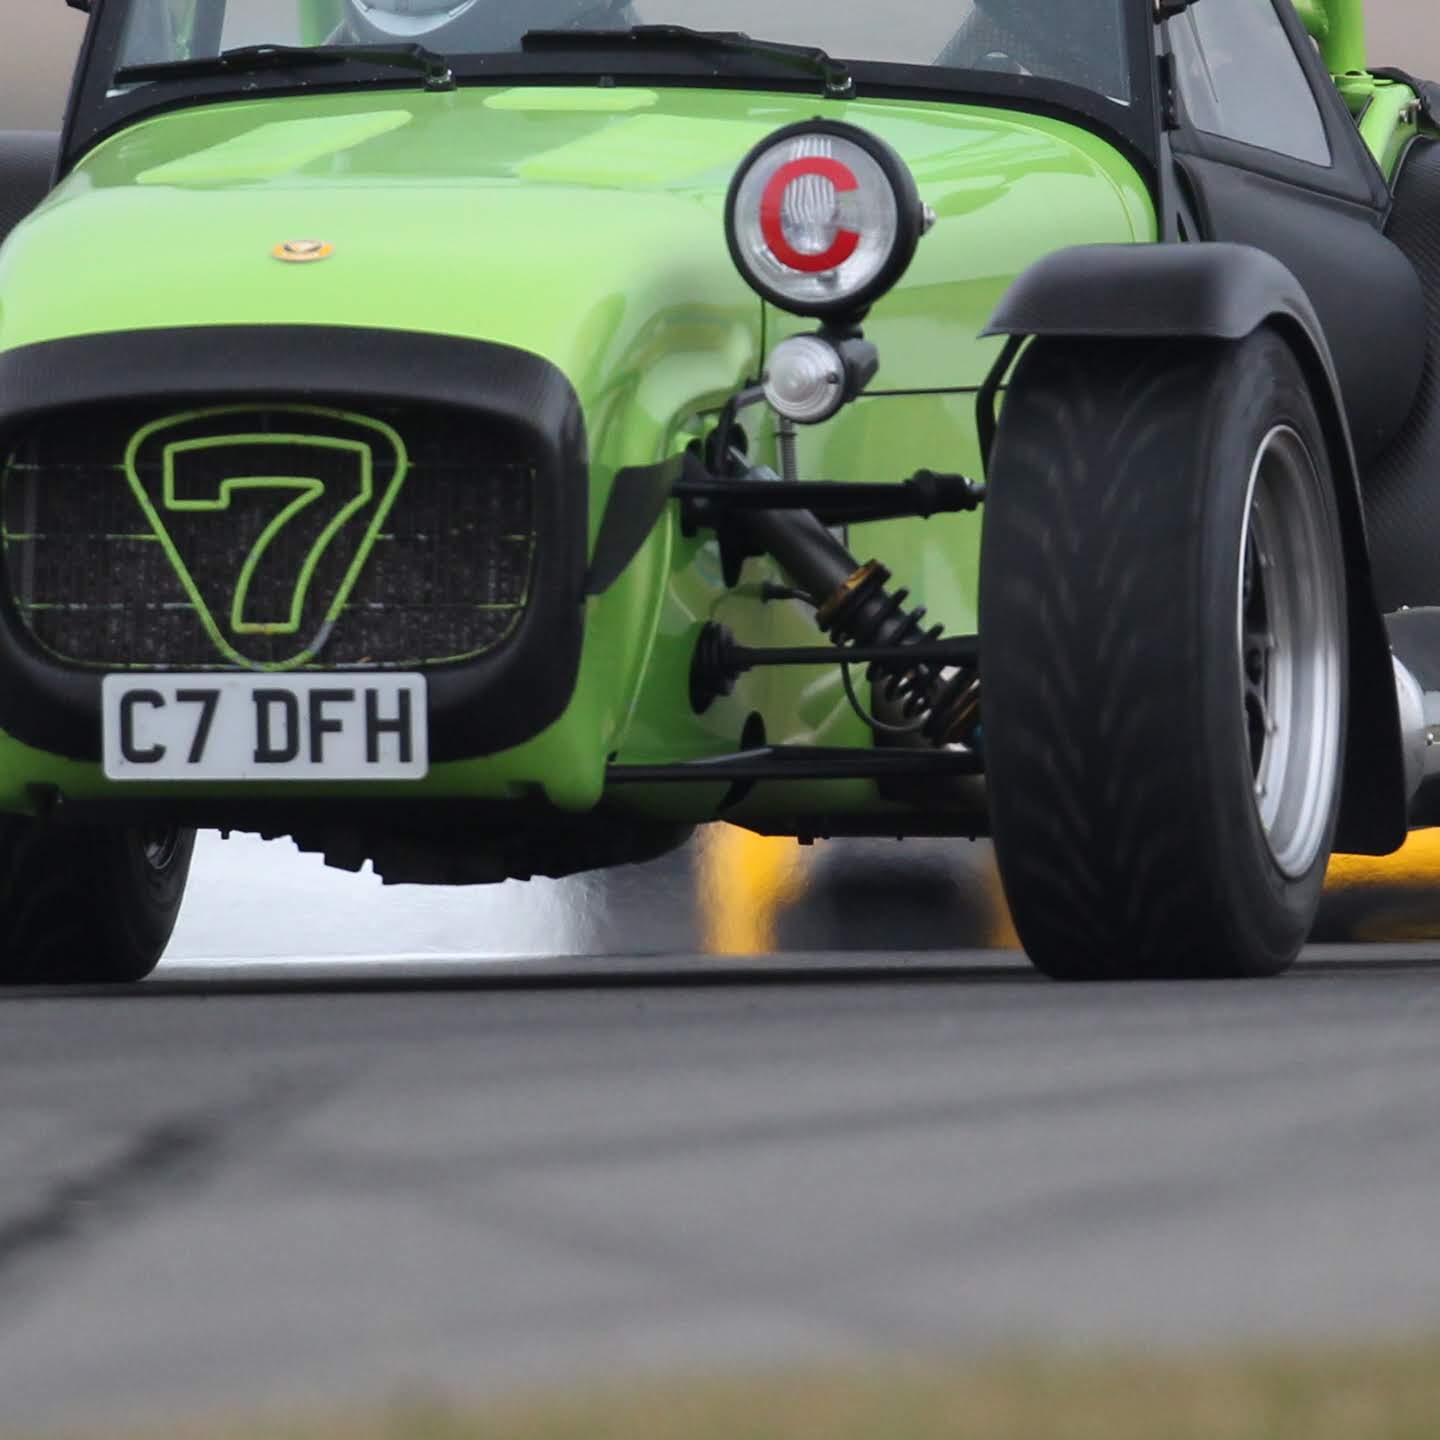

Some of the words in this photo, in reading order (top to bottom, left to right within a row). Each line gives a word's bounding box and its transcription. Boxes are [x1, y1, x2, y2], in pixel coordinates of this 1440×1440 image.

[759, 156, 861, 273] C
[164, 432, 373, 635] 7
[118, 688, 222, 765] C7
[253, 687, 413, 764] DFH
